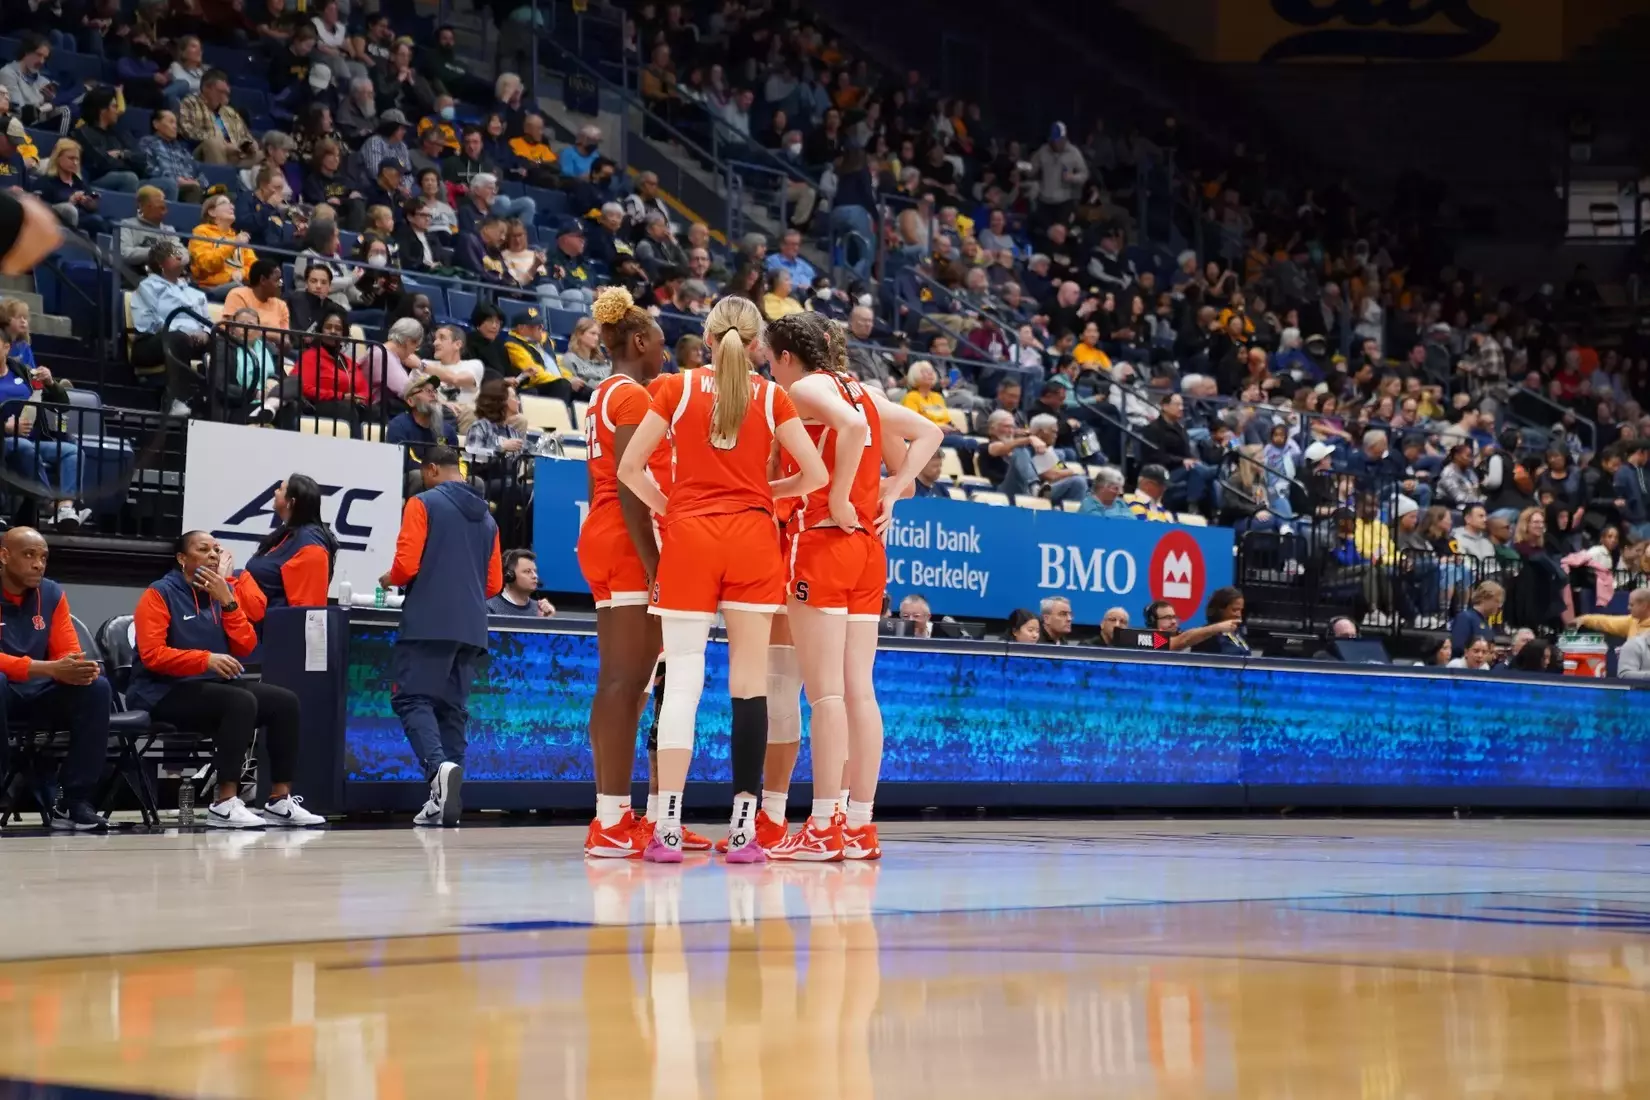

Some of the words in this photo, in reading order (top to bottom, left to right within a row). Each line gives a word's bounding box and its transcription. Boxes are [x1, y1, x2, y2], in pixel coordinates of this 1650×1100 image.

[223, 479, 384, 538] AC
[887, 518, 931, 549] ficial
[936, 522, 981, 553] bank
[911, 560, 990, 598] Berkeley
[1037, 543, 1137, 595] BMO
